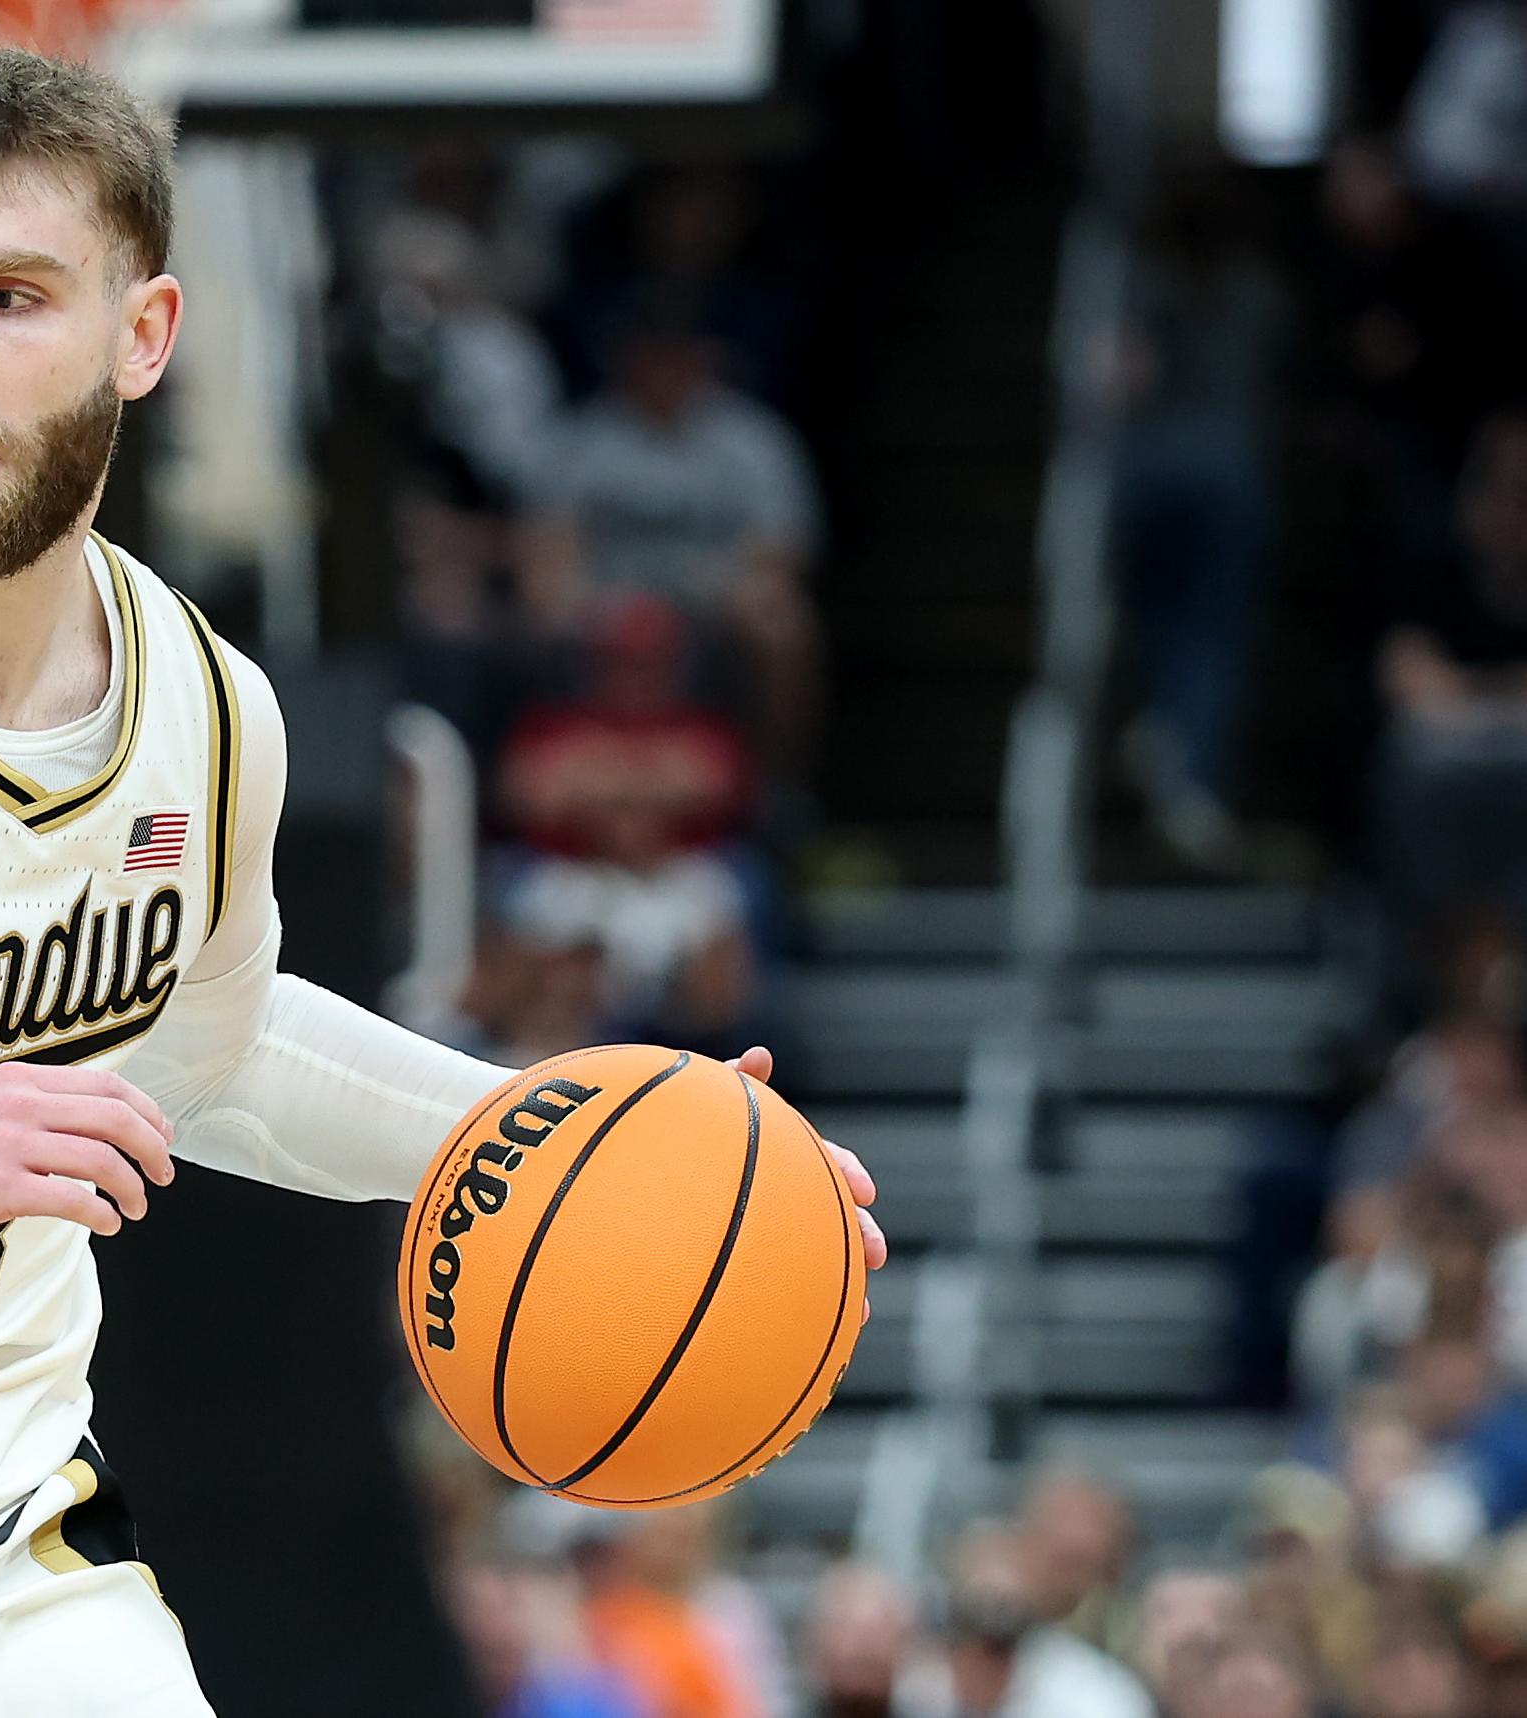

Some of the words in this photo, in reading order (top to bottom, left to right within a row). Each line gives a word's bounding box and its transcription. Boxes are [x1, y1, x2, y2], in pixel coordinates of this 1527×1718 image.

[445, 1148, 470, 1187] EVO
[426, 1077, 604, 1352] Wilson
[427, 1193, 445, 1235] NXT
